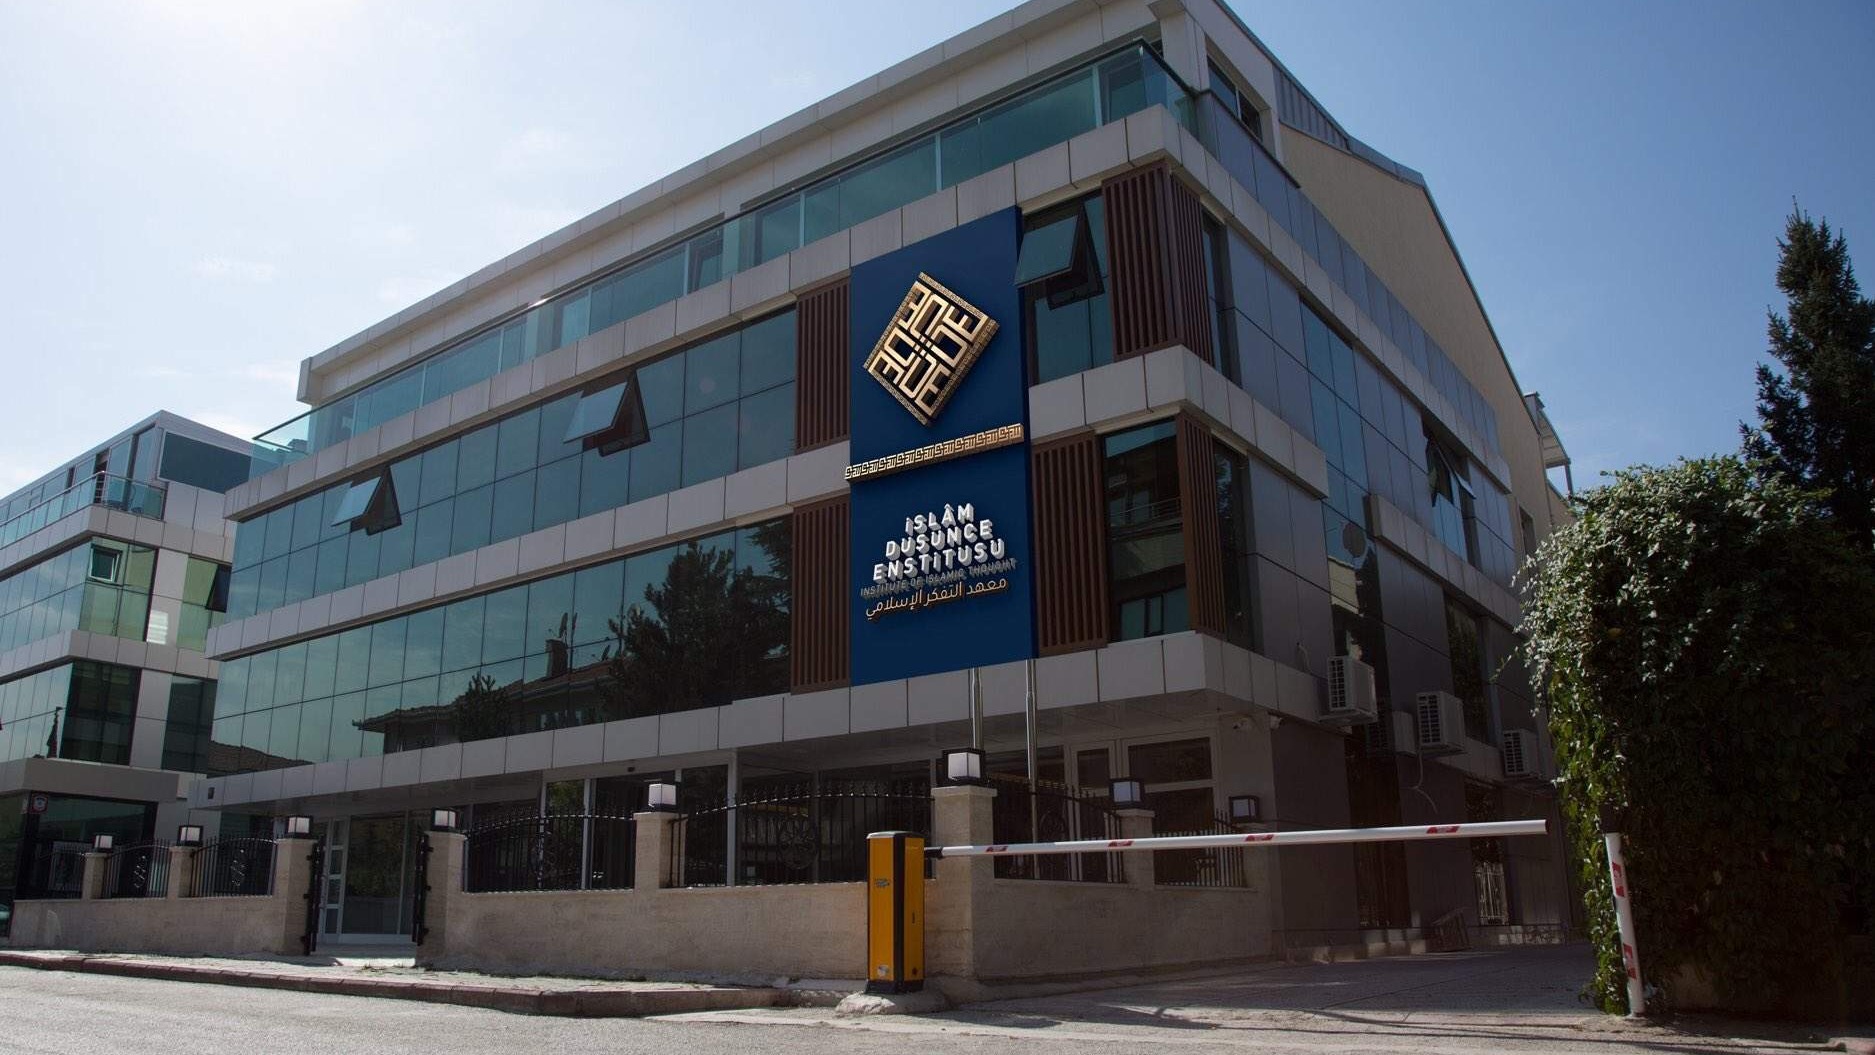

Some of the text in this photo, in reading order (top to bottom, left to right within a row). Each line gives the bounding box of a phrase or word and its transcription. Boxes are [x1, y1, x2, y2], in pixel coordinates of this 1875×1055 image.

[925, 567, 968, 587] ISLAMIC
[865, 577, 1008, 620] معهد التفكر الإسلامي
